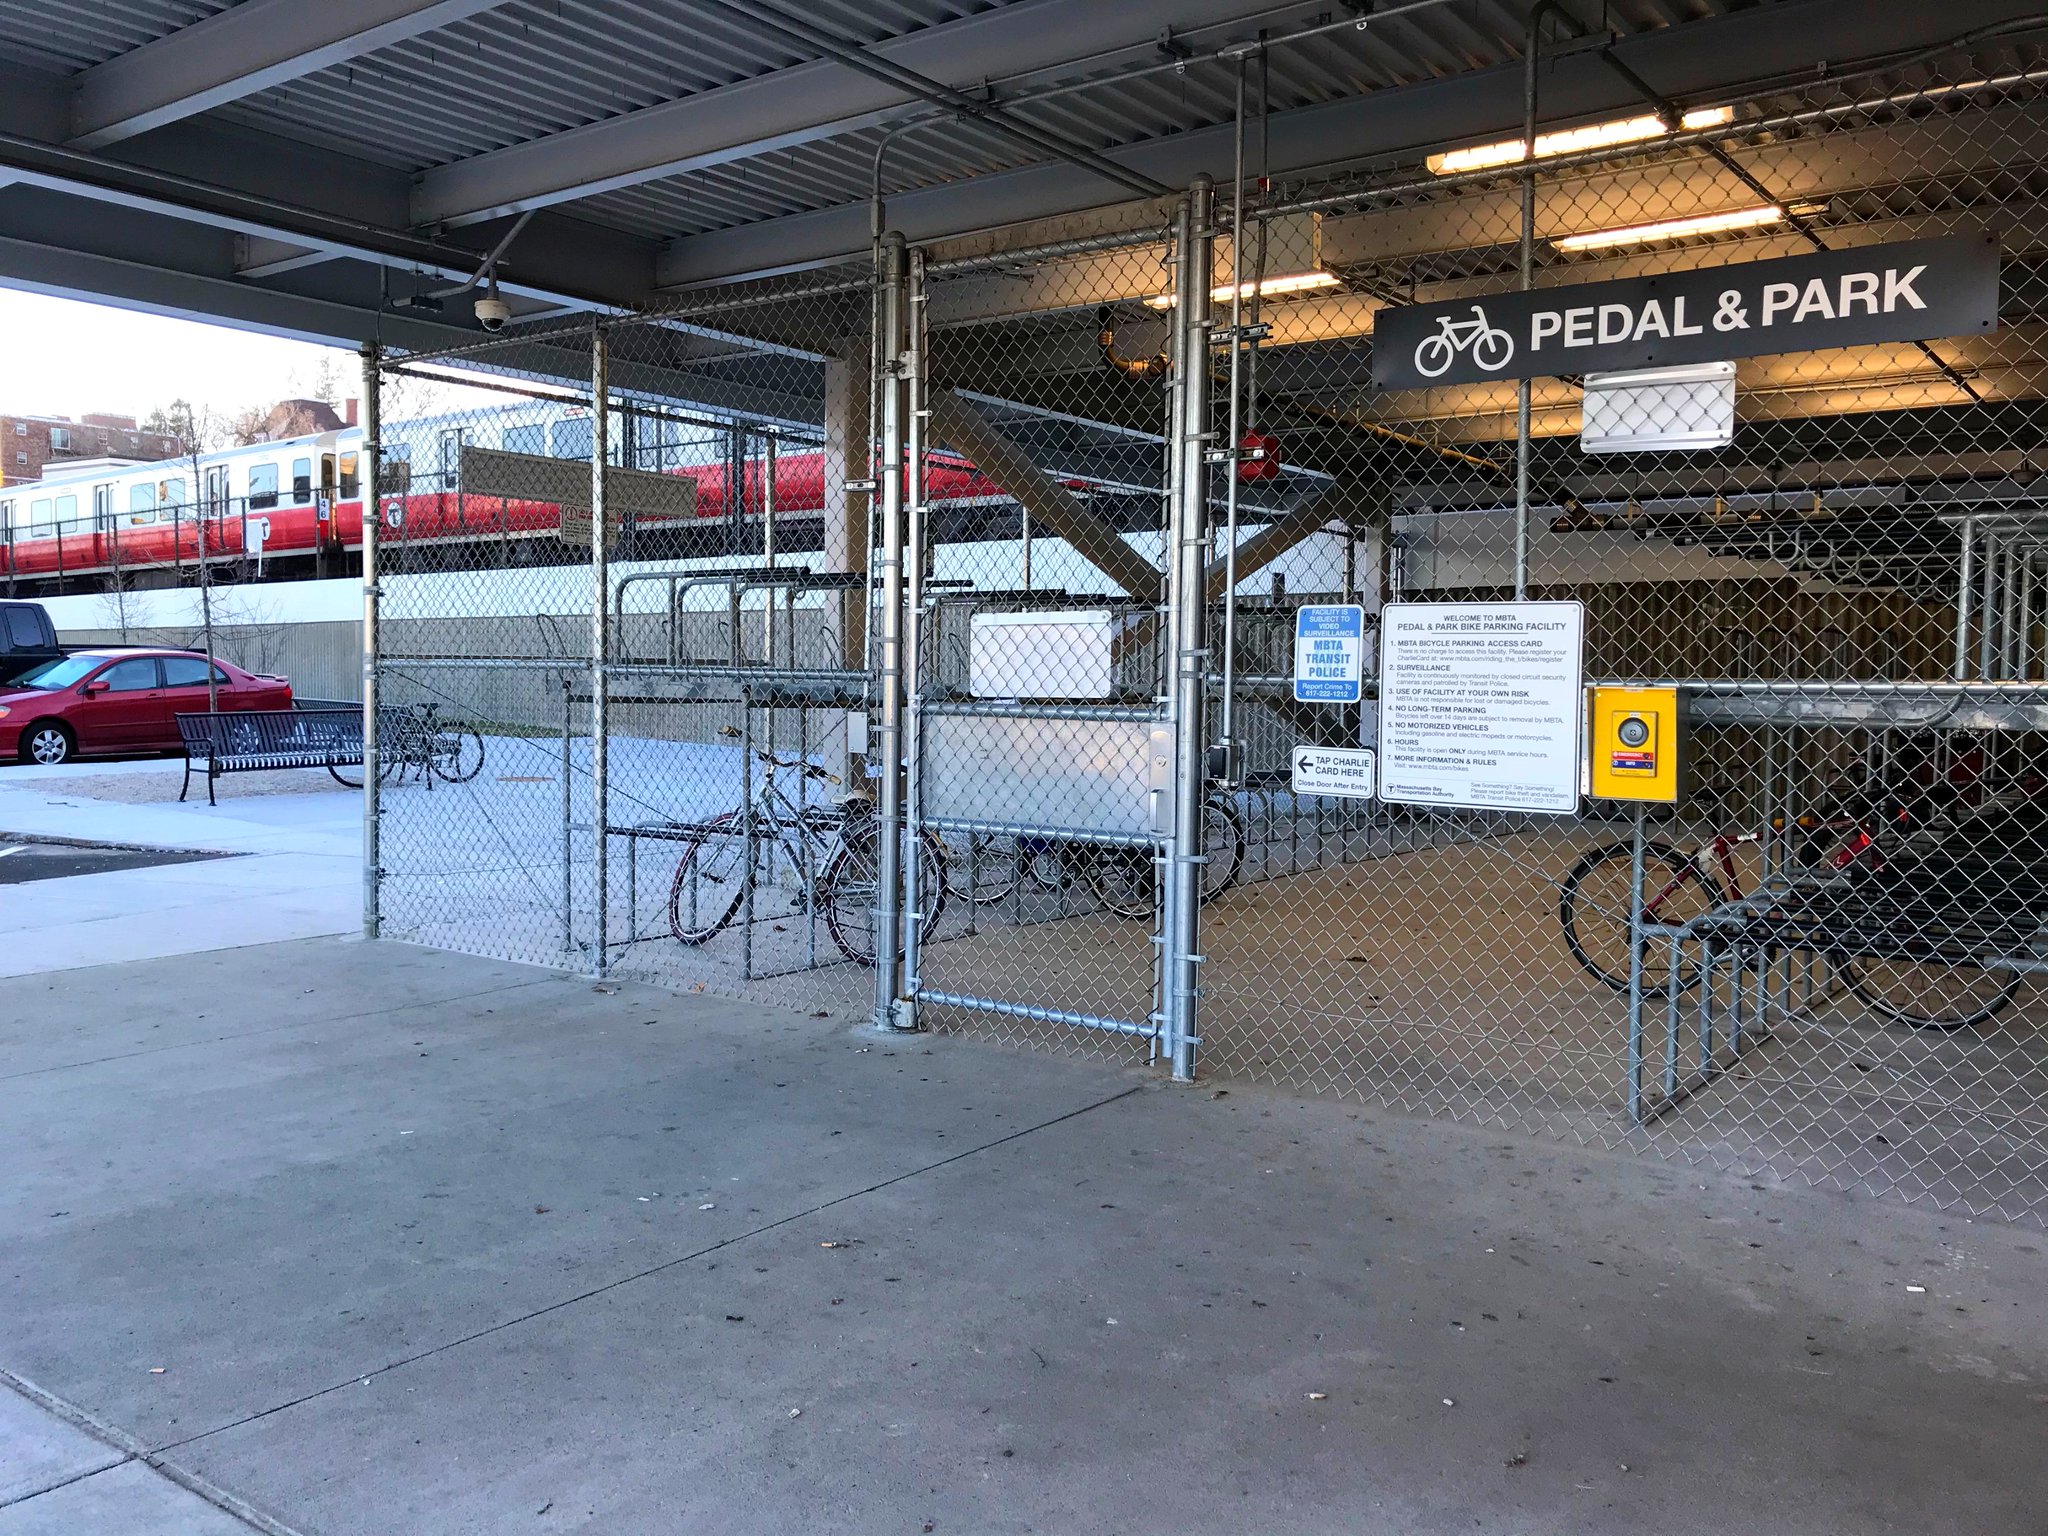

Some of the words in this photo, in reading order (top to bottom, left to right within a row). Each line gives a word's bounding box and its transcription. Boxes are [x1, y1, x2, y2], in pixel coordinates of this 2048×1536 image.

[1531, 298, 1703, 351] PEDAL
[1712, 290, 1750, 332] &
[1763, 264, 1927, 327] PARK
[1427, 623, 1433, 631] &
[1435, 623, 1458, 631] PARK
[1314, 640, 1343, 650] MBTA
[1305, 654, 1351, 664] TRANSIT
[1309, 667, 1346, 677] POLICE
[1408, 705, 1451, 713] LONG-TERM
[1408, 722, 1451, 730] MOTORIZED
[1515, 734, 1554, 742] motorcycles.
[1316, 756, 1331, 764] TAP
[1333, 758, 1370, 767] CHARLIE
[1416, 756, 1464, 764] INFORMATION
[1409, 763, 1469, 771] www.mbta.com/bikes
[1315, 767, 1339, 775] CARD
[1341, 769, 1364, 777] HERE
